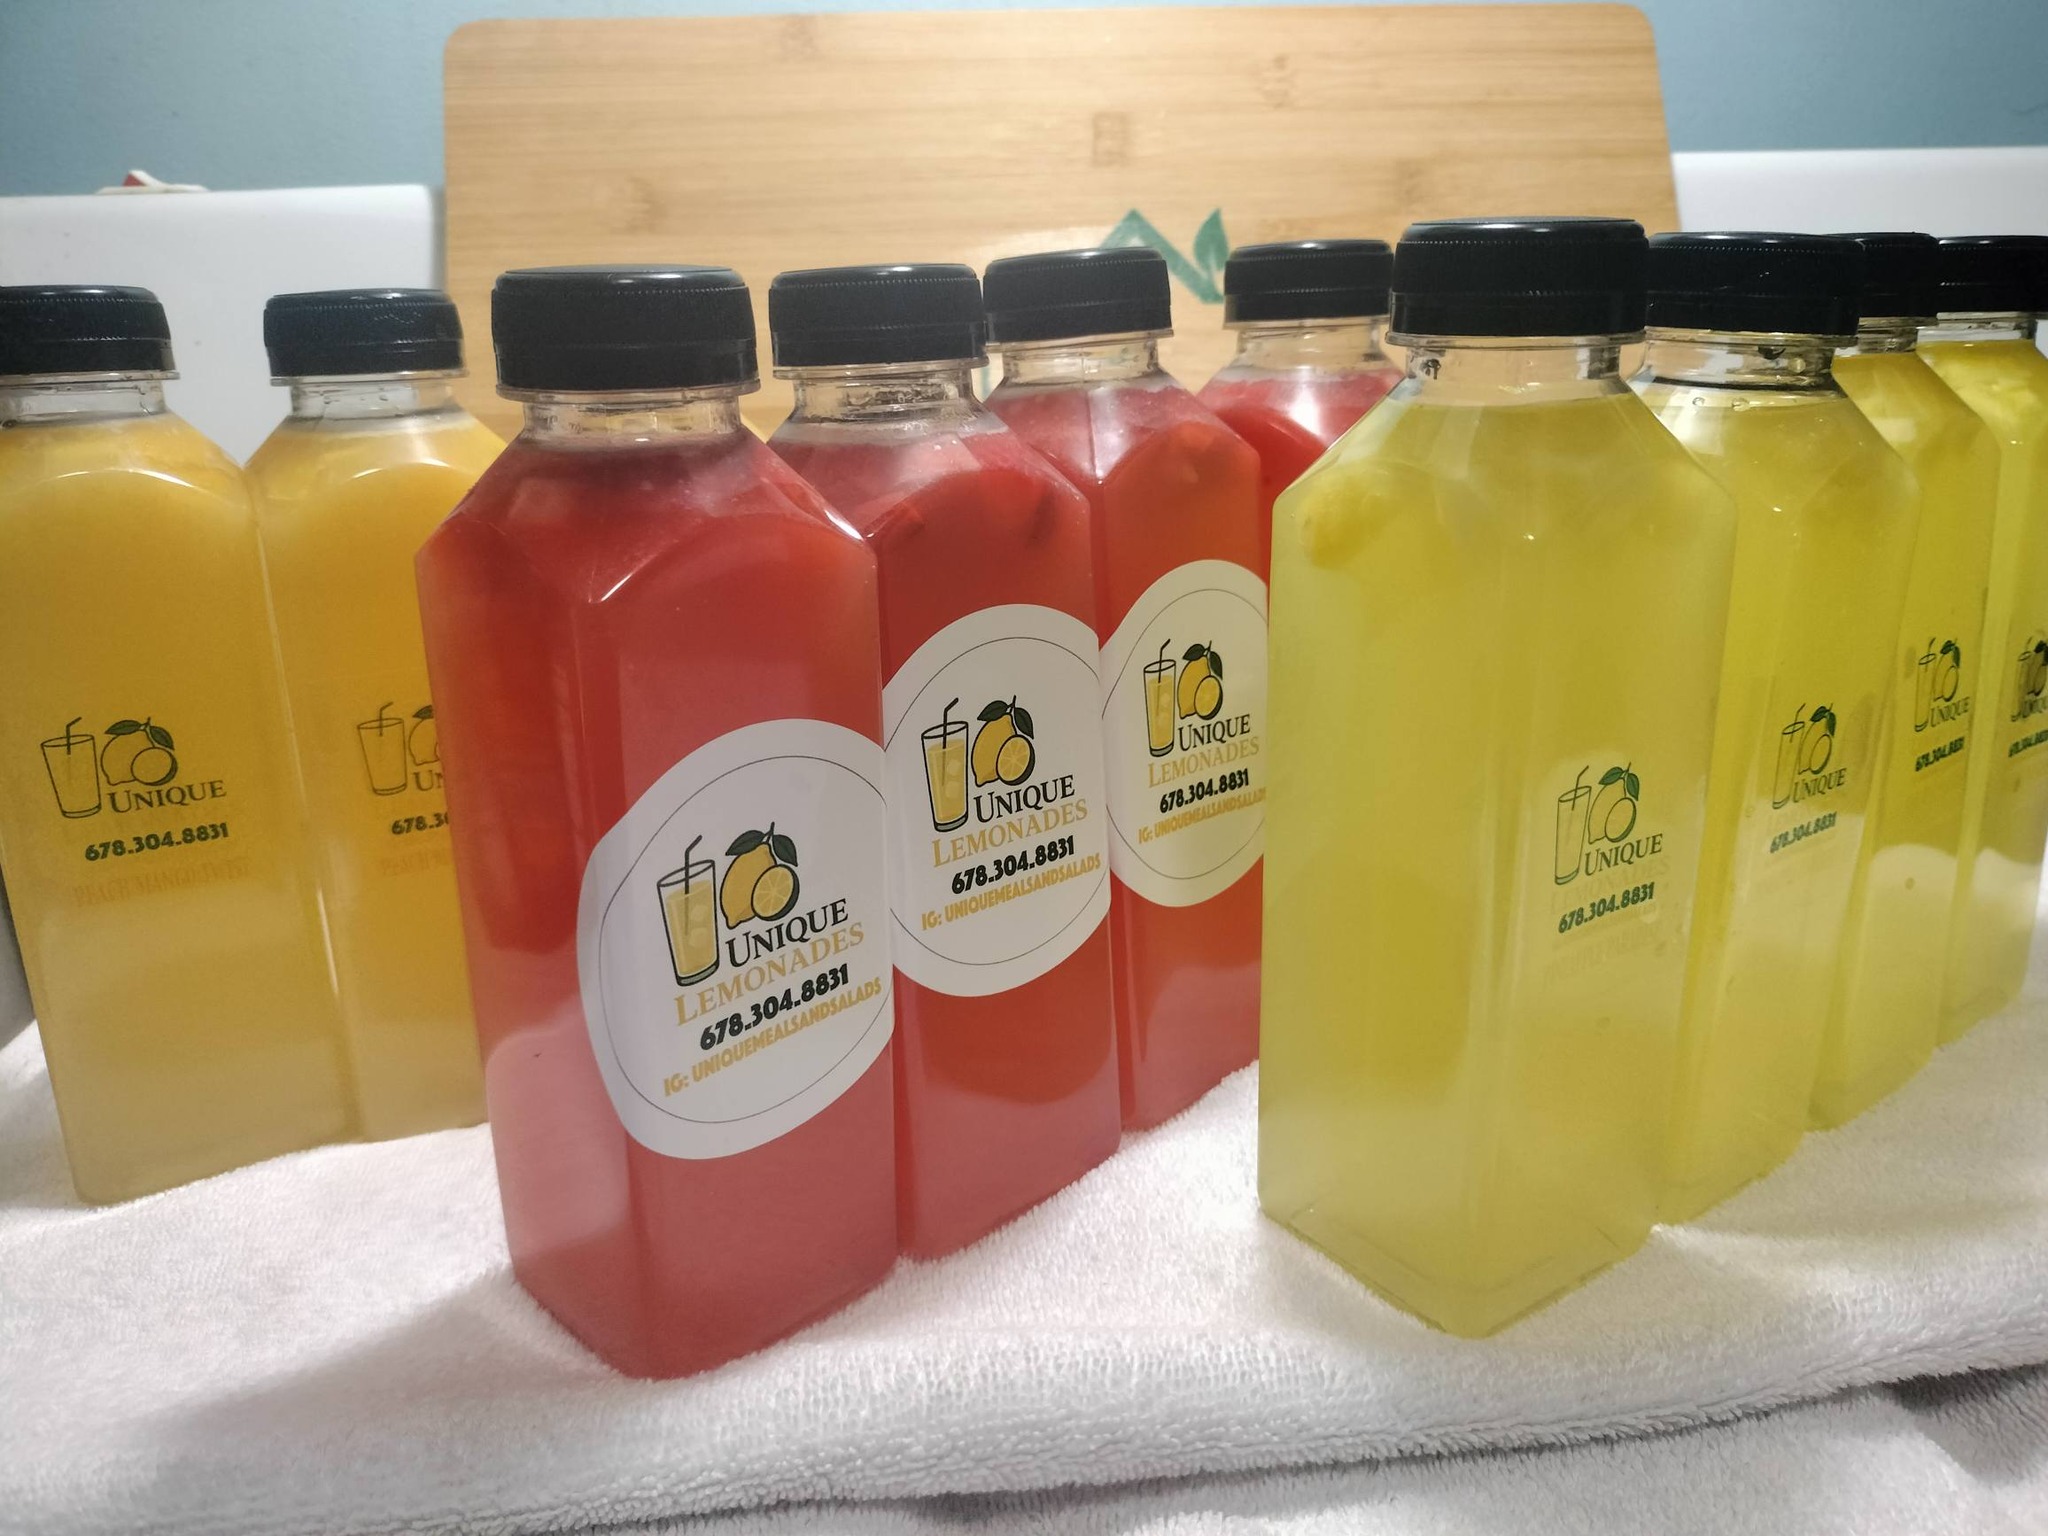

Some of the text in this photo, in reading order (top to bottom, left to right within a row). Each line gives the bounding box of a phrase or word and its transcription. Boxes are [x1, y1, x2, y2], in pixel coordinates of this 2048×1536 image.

[1177, 714, 1251, 752] UNIQUE
[1148, 736, 1260, 788] LEMONADES
[1793, 767, 1847, 803] UNIQUE
[108, 779, 227, 814] UNIQUE
[973, 774, 1076, 823] UNIQUE
[1160, 768, 1249, 814] 678.304.8831
[84, 822, 229, 862] 678.304.8831
[931, 798, 1088, 868] LEMONADES
[1138, 826, 1153, 844] IG:
[1585, 833, 1663, 876] UNIQUE
[951, 835, 1075, 895] 678.304.8831
[921, 853, 1101, 931] IG: UNIQUEMEALSANDSALADS
[1558, 882, 1655, 934] 678.304.8831
[725, 898, 849, 967] UNIQUE
[674, 921, 864, 1027] LEMONADES
[700, 963, 849, 1051] 678.304.8831
[663, 976, 883, 1097] IG: UNIQUEMEALSANDSALADS
